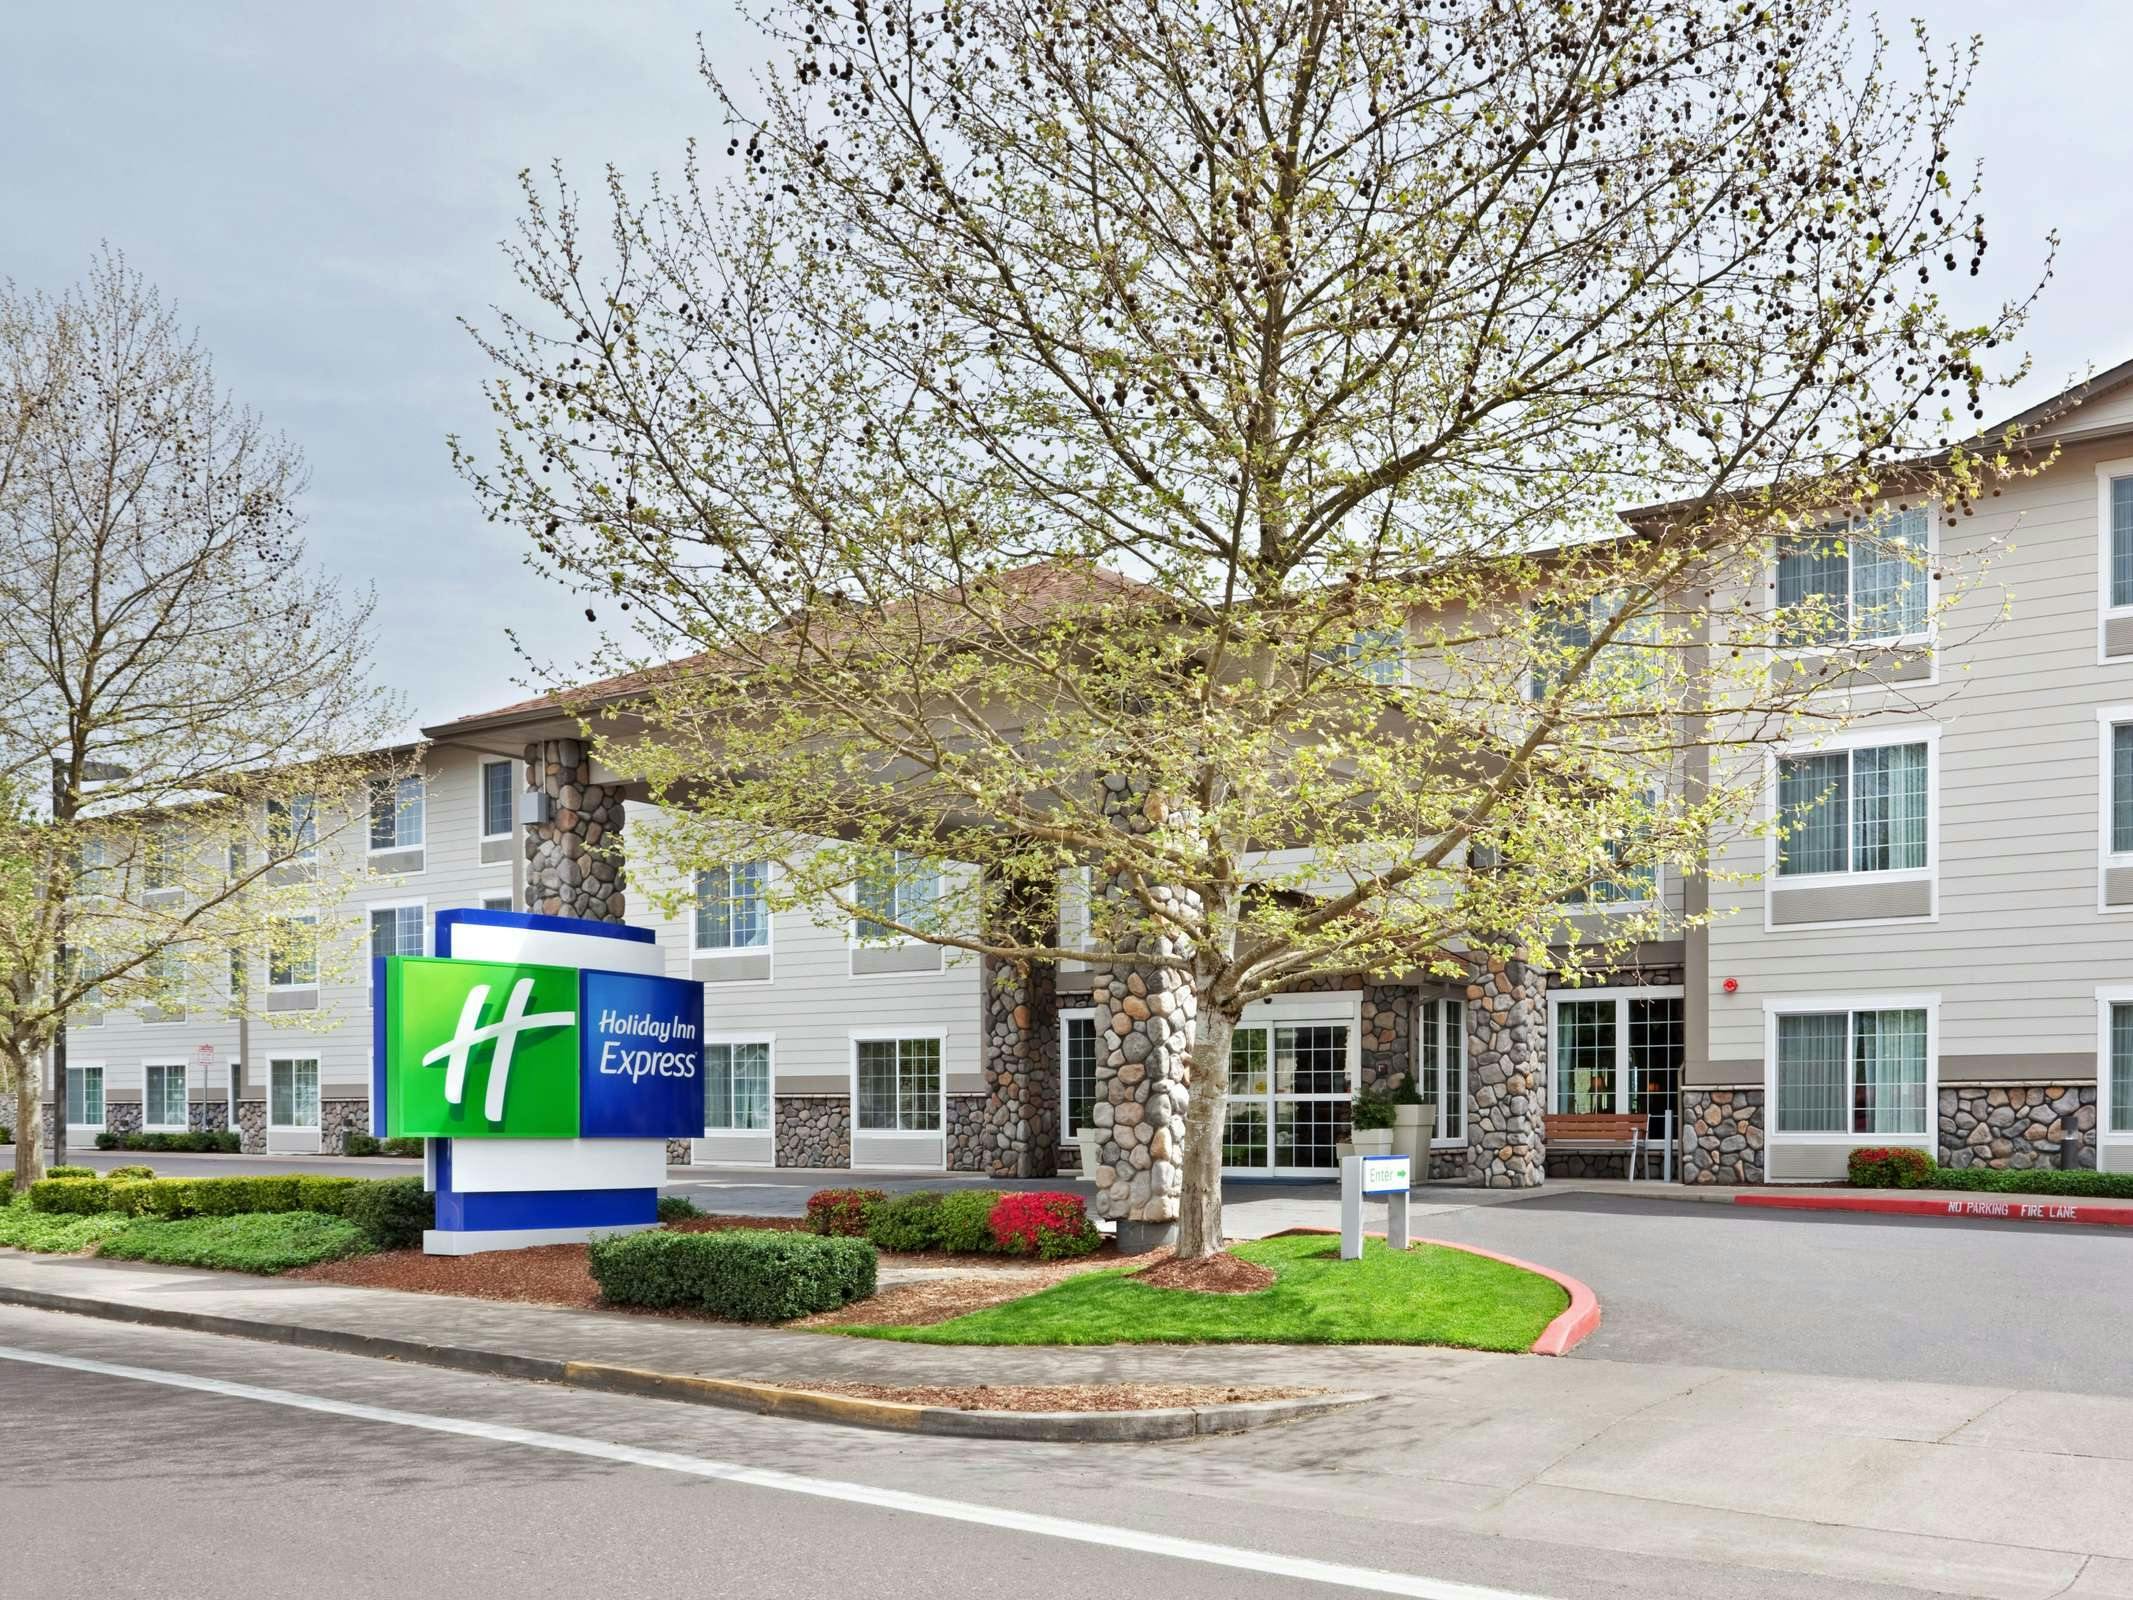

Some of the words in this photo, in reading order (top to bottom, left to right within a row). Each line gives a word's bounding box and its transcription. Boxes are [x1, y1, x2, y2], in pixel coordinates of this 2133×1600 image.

[598, 1009, 671, 1043] Holiday
[672, 1015, 696, 1040] Inn
[422, 978, 575, 1121] H
[600, 1041, 696, 1084] Express
[1370, 1168, 1393, 1183] Enter
[1948, 1201, 1962, 1213] NO
[1966, 1202, 2009, 1216] PARKING
[2020, 1204, 2044, 1217] FIRE
[2049, 1206, 2078, 1218] LANE
